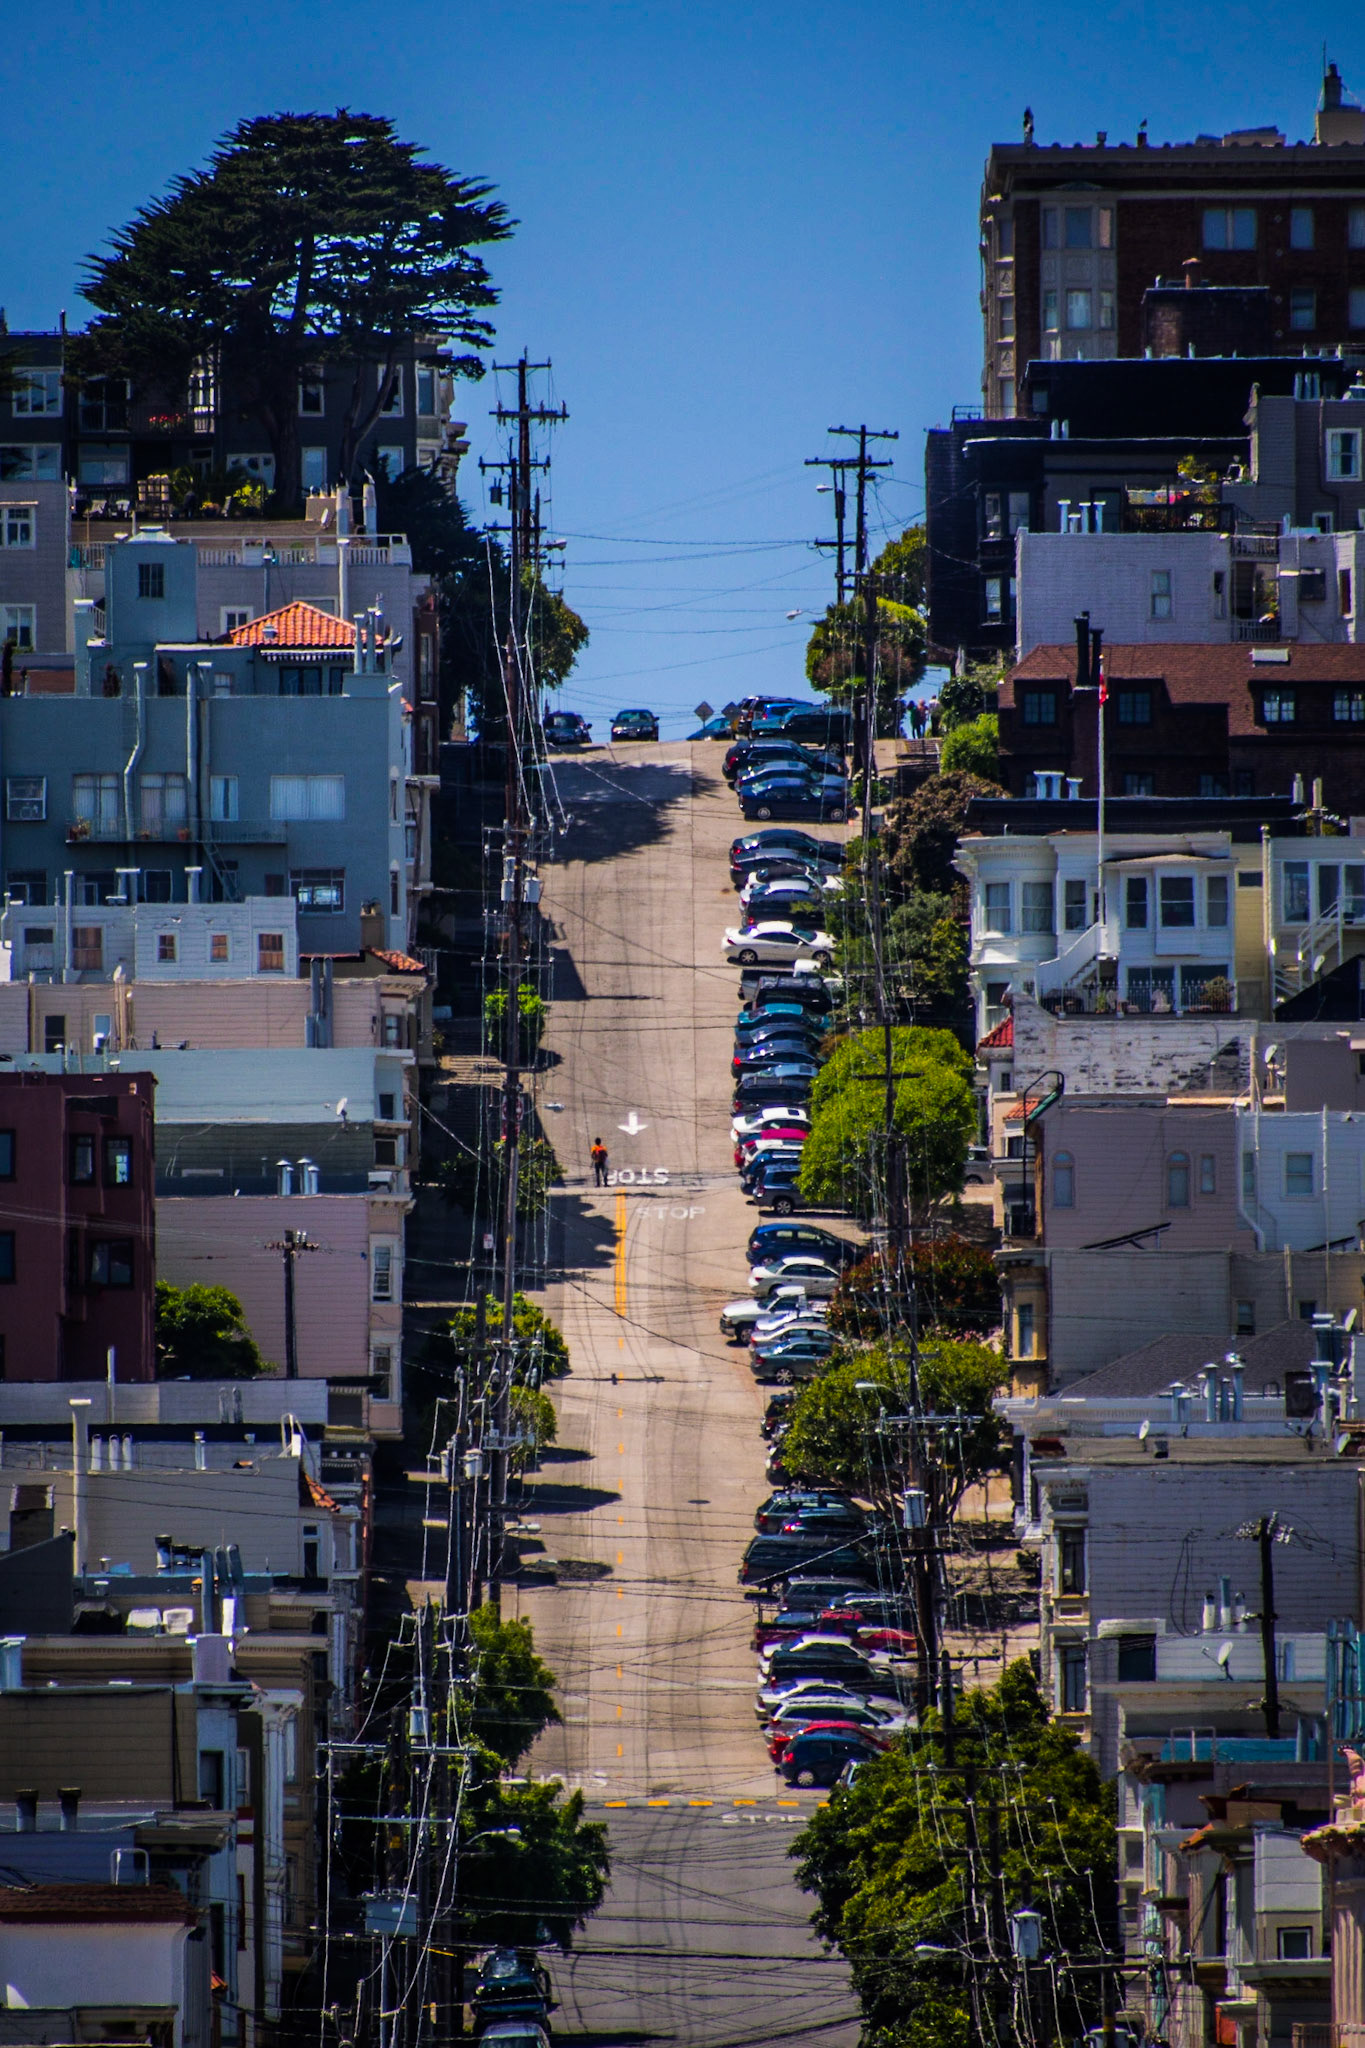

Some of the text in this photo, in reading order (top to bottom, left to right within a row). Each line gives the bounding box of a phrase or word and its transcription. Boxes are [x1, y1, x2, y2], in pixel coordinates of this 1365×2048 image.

[606, 1167, 669, 1185] STOP
[636, 1206, 705, 1220] STOP
[722, 1814, 807, 1824] STOP
